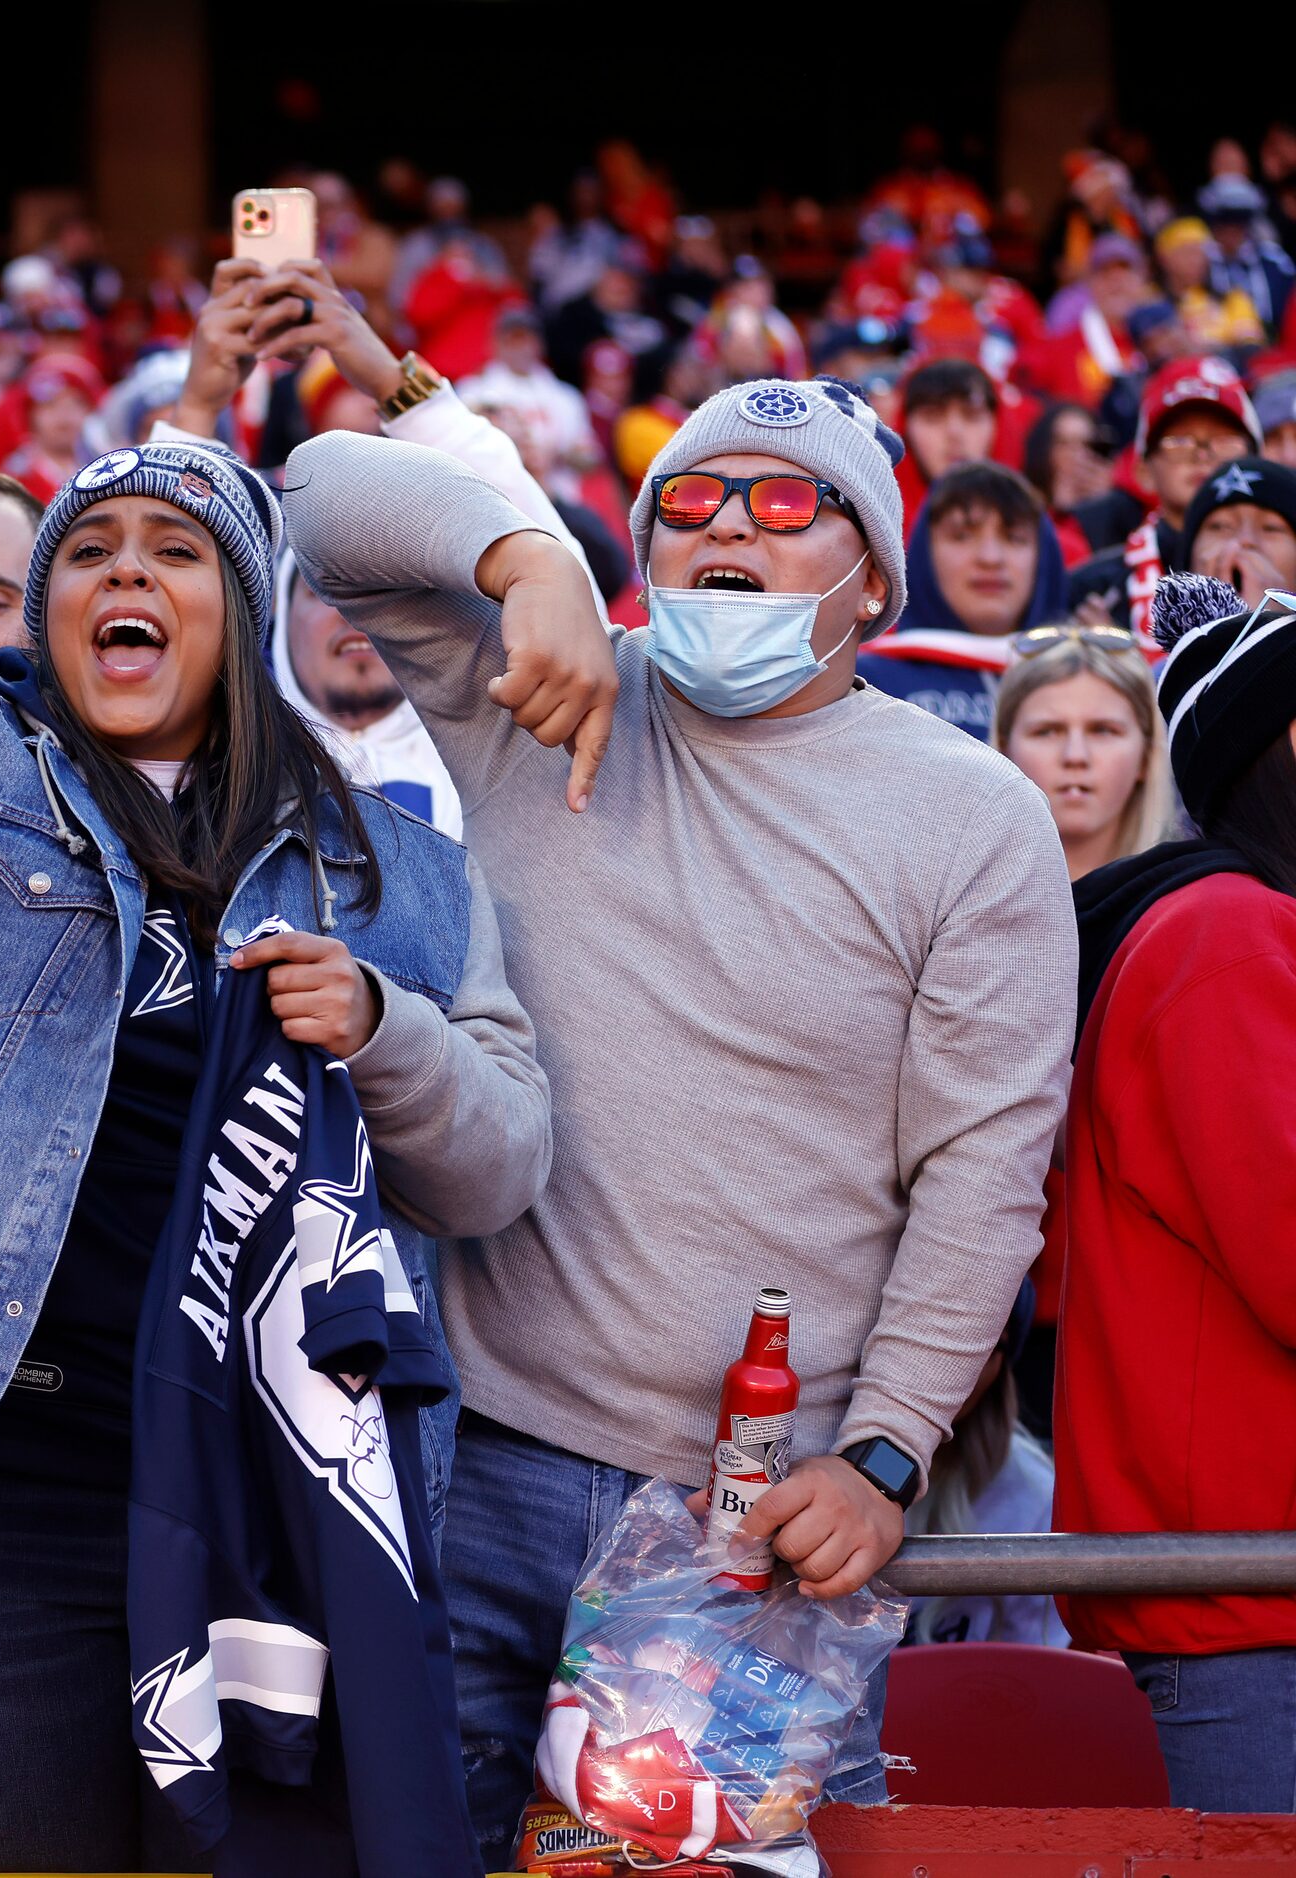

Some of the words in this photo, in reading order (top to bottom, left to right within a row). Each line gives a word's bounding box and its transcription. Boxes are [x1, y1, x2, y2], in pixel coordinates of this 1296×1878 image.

[759, 388, 803, 403] DALLAS
[747, 406, 798, 422] COWBOYS
[179, 1062, 305, 1362] AIKMAN
[535, 1828, 618, 1856] HOTHANDS
